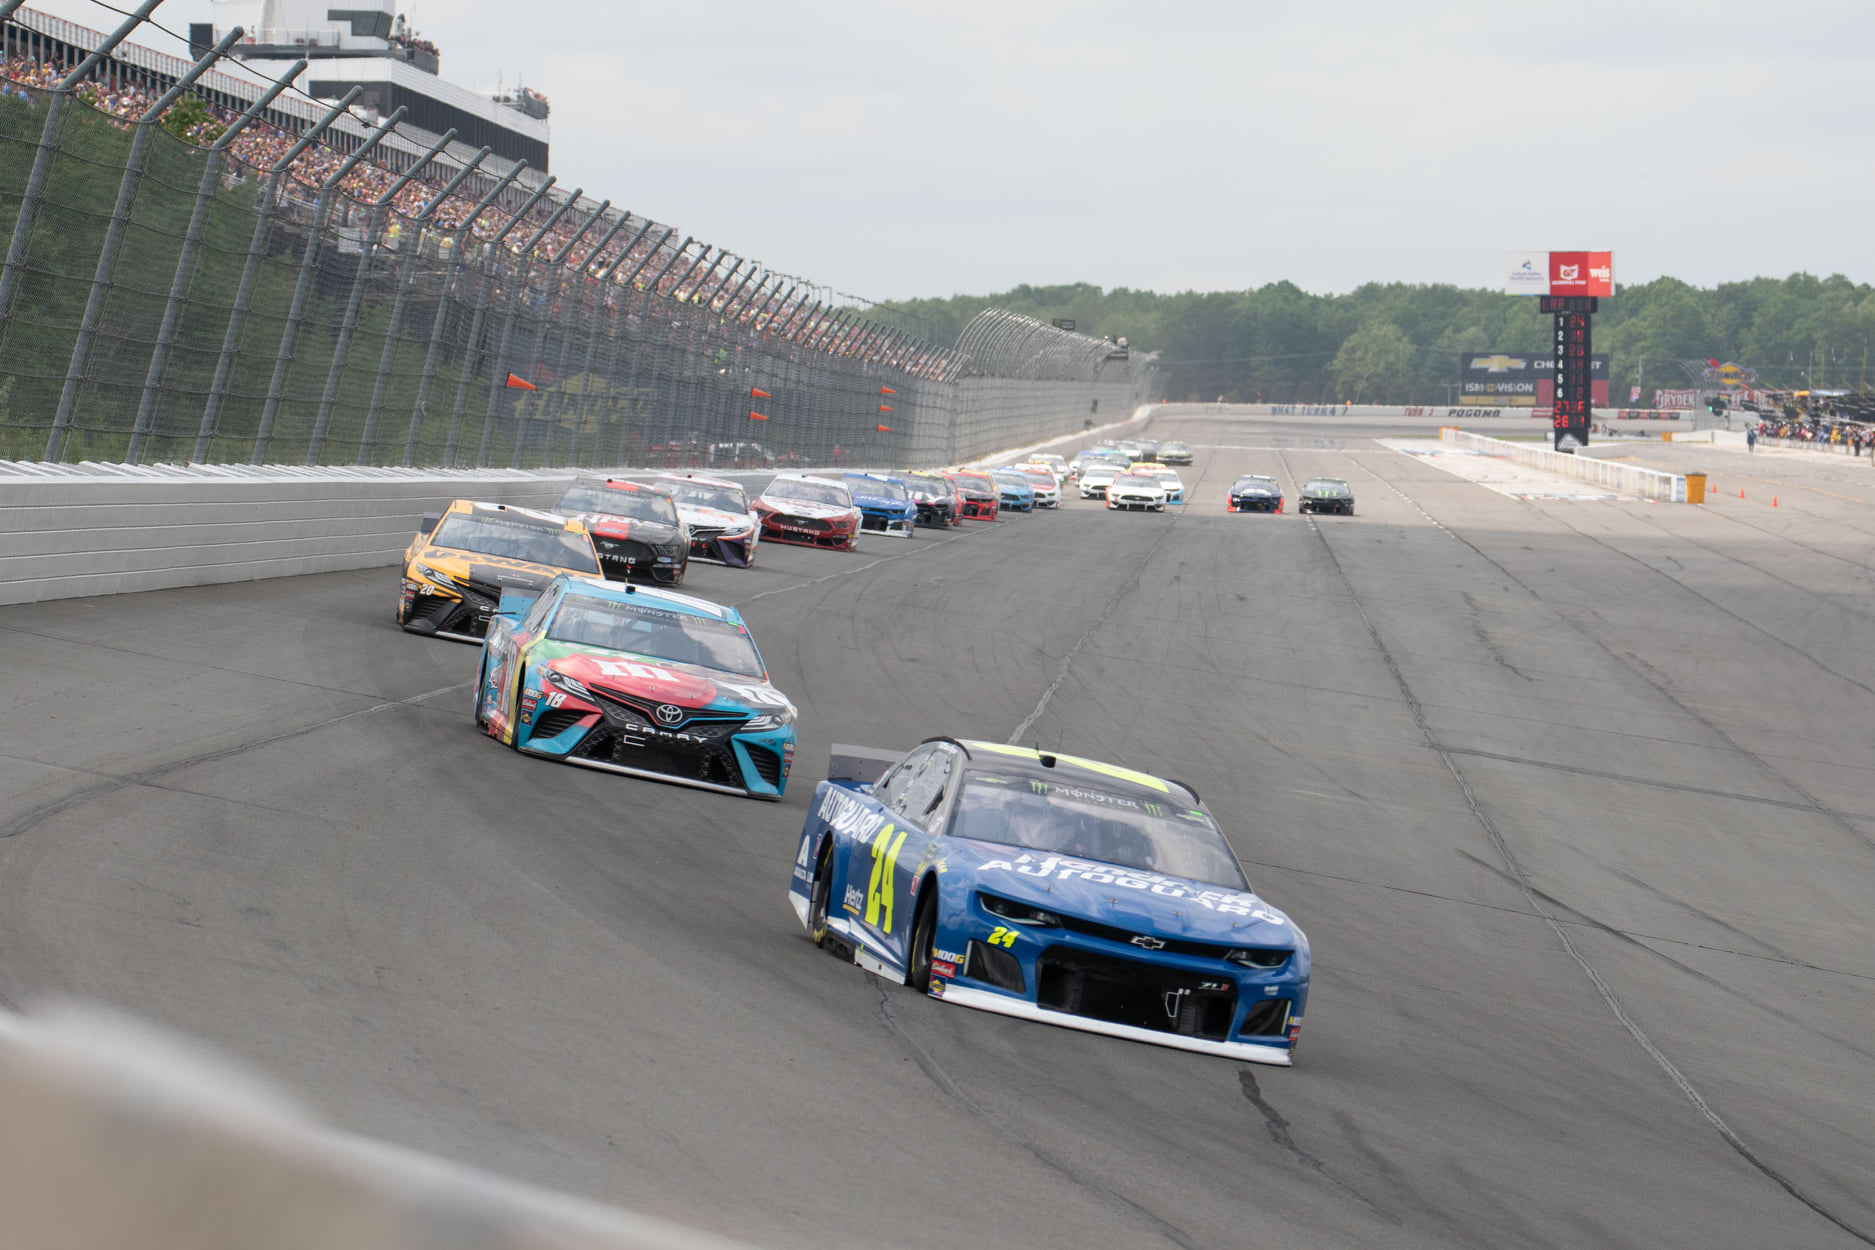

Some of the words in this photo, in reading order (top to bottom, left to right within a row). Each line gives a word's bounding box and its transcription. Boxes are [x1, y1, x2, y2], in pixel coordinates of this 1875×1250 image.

[1542, 299, 1565, 311] LAP
[1559, 316, 1564, 327] 1
[1570, 315, 1585, 327] 24
[1558, 330, 1564, 341] 2
[1558, 345, 1564, 355] 3
[1557, 359, 1563, 369] 4
[1557, 373, 1563, 384] 5
[1465, 383, 1484, 392] ISM
[1496, 383, 1533, 392] VISION
[1557, 388, 1563, 398] 6
[1656, 391, 1696, 408] DRYDEN
[780, 524, 820, 536] MUSTANG
[419, 583, 436, 596] 20
[626, 606, 689, 621] MONSTER
[545, 691, 568, 708] 18
[625, 723, 709, 743] CAMRY
[1056, 786, 1139, 809] MONSTER
[864, 823, 908, 935] 24
[844, 883, 864, 911] Hertz
[976, 860, 1285, 926] AUTOGUARD
[987, 926, 1020, 949] 24
[932, 948, 965, 964] MOOG
[1199, 981, 1230, 992] ZL1
